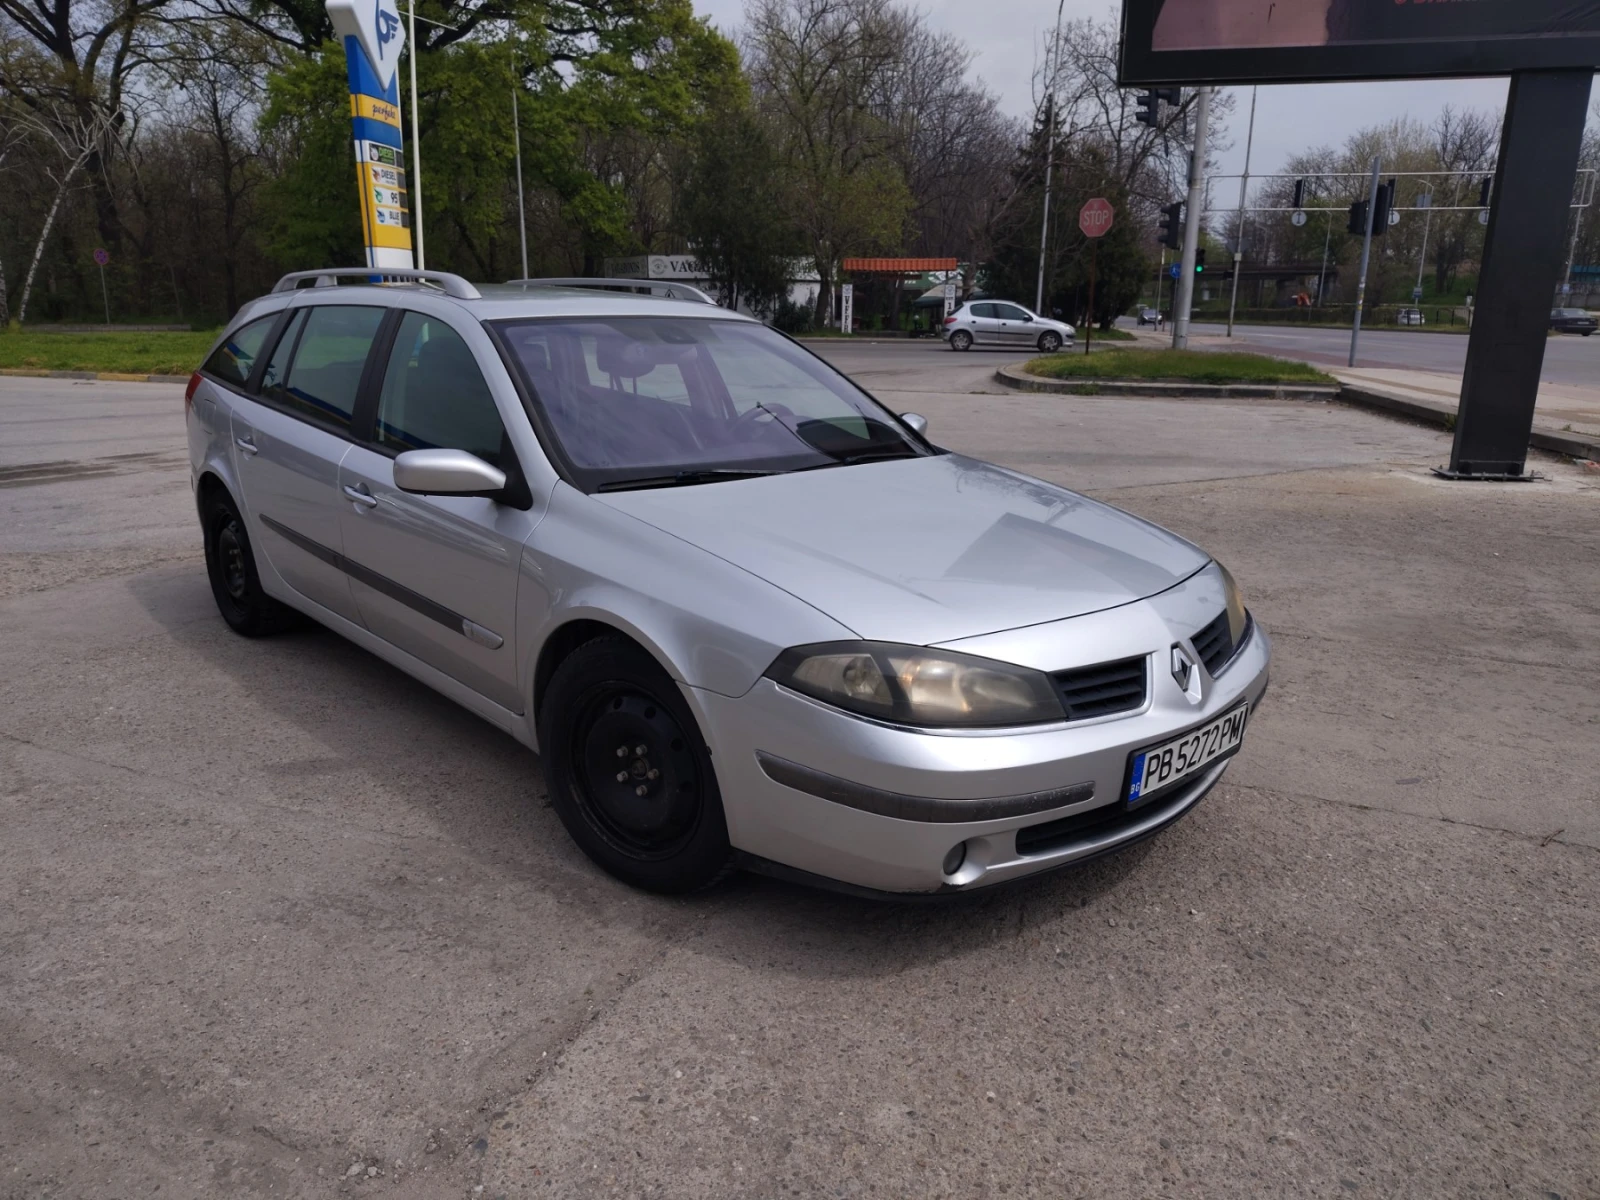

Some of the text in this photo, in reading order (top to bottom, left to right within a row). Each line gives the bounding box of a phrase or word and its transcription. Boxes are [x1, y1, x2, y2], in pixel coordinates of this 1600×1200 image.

[381, 169, 397, 181] DIESEL
[390, 192, 398, 204] 95
[1083, 209, 1109, 226] STOP
[1144, 710, 1244, 789] PB 5272 PM
[1130, 781, 1141, 795] BG
